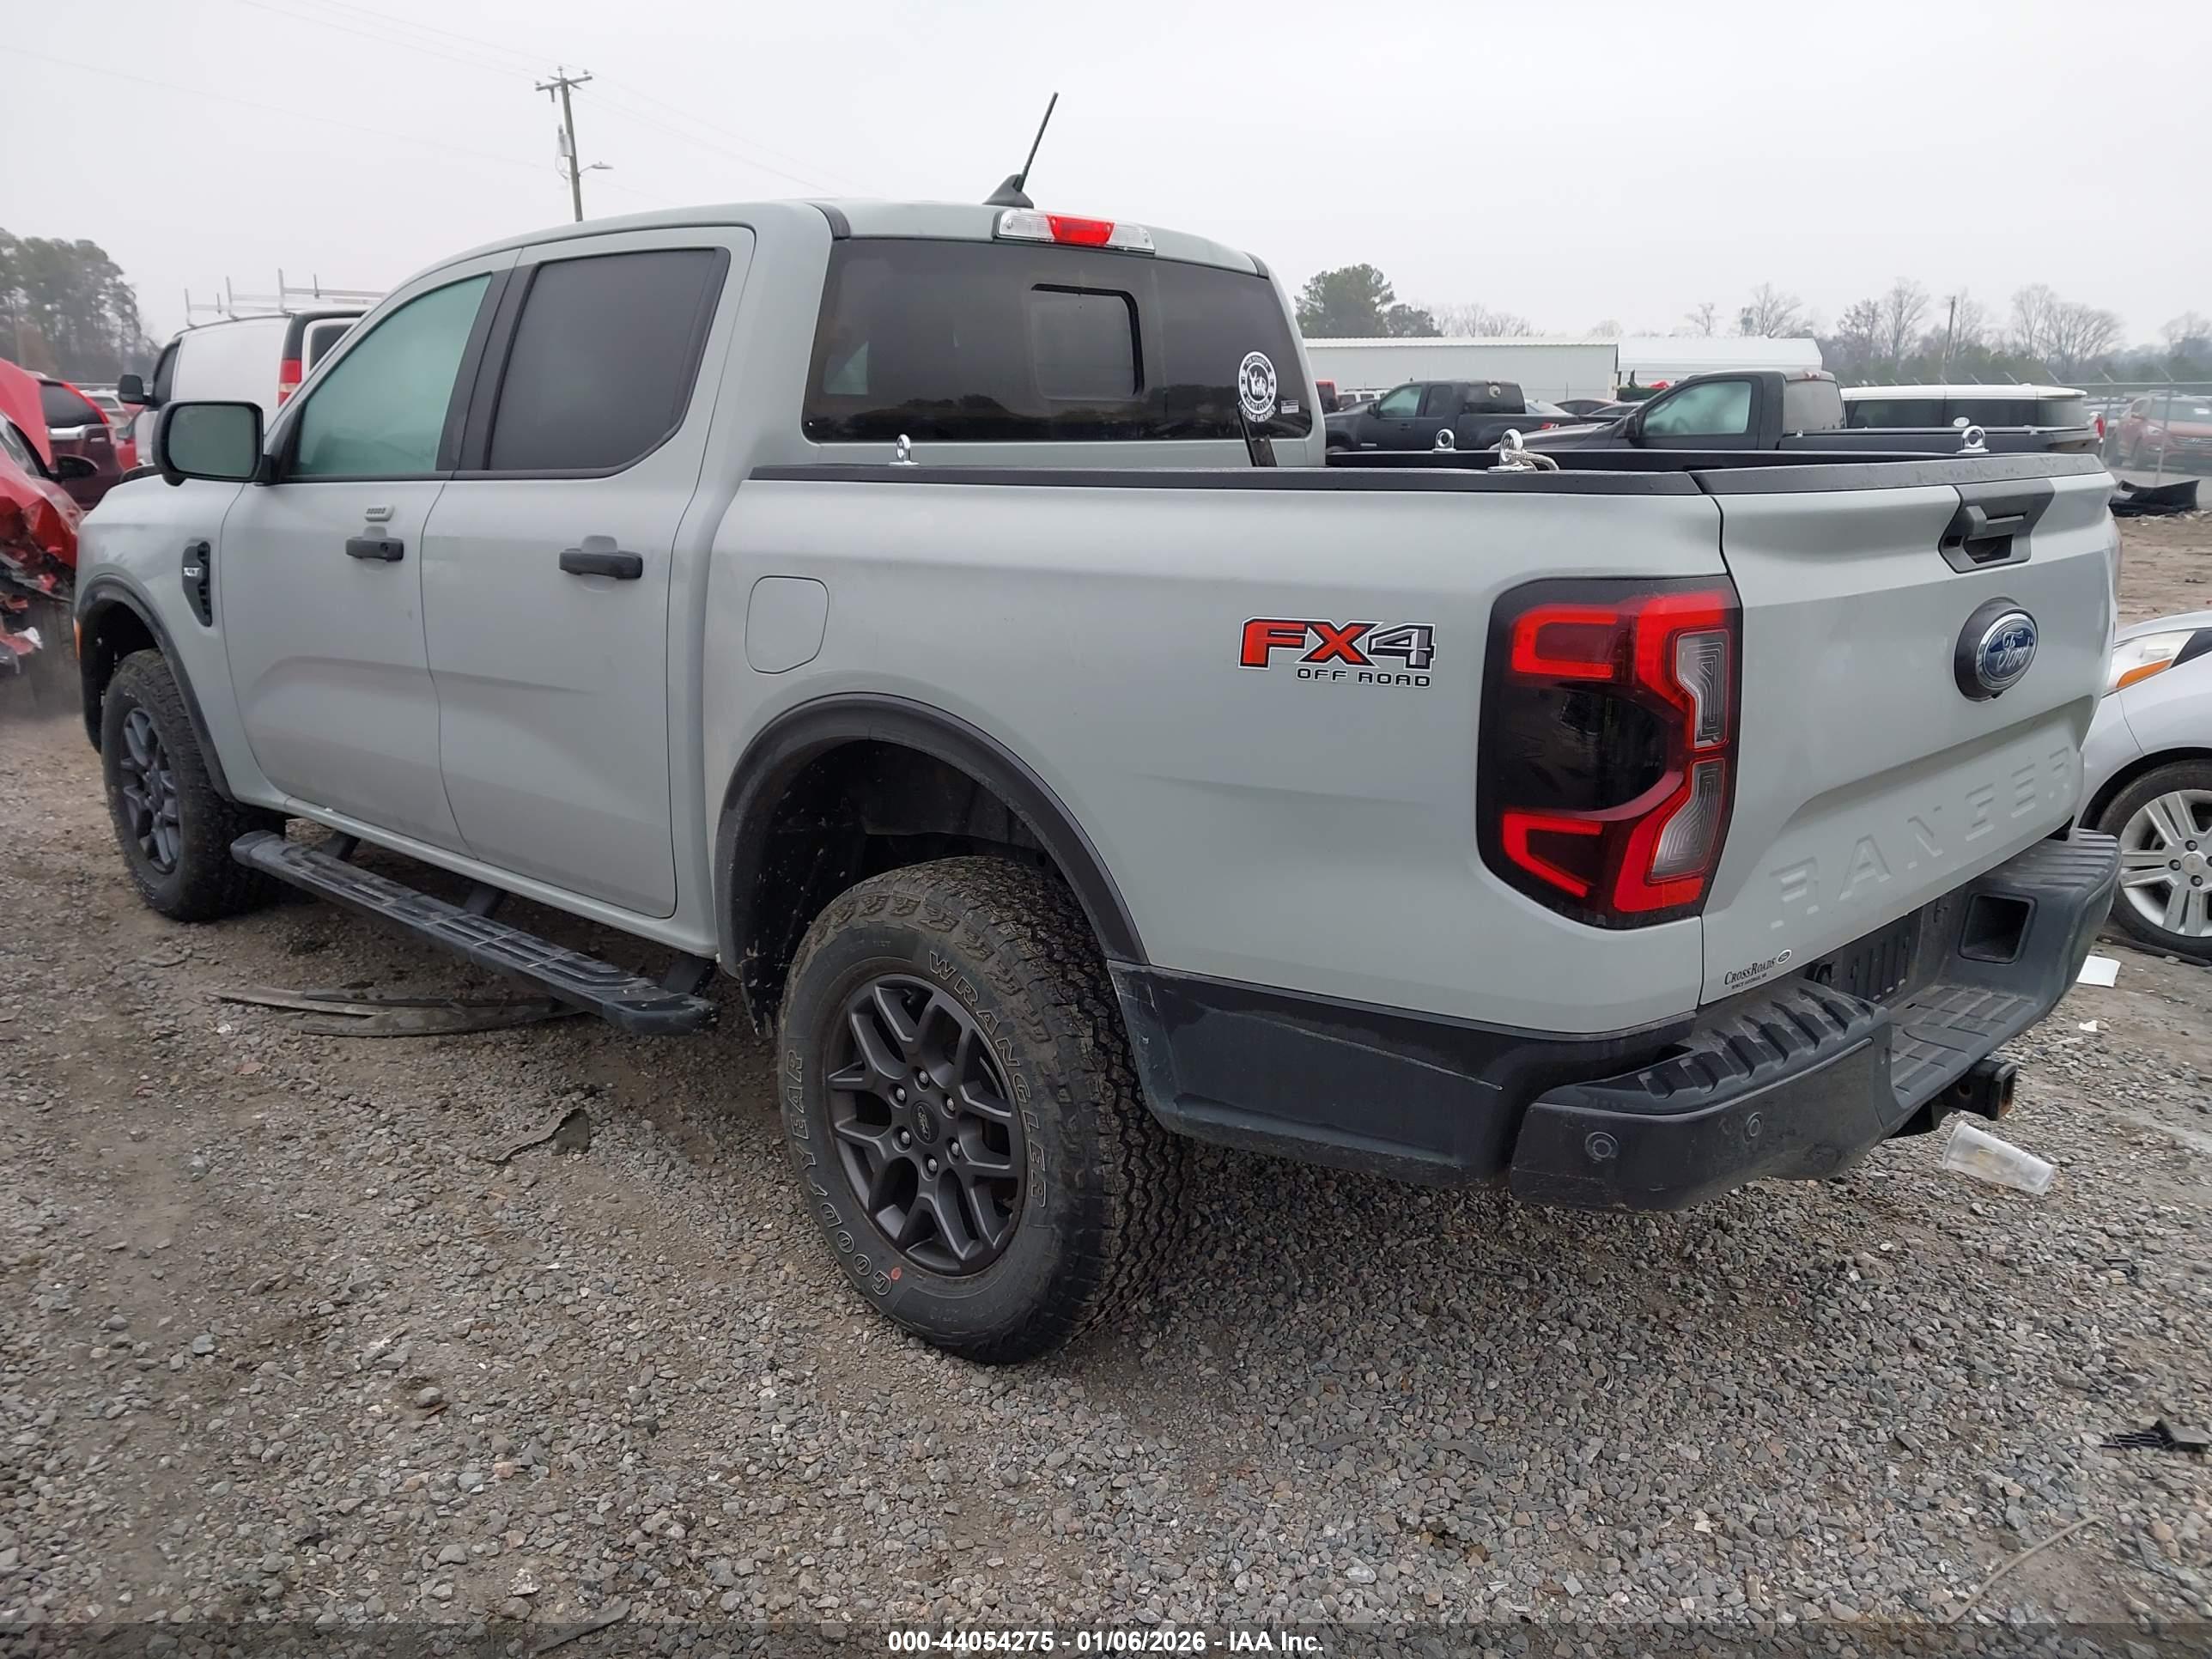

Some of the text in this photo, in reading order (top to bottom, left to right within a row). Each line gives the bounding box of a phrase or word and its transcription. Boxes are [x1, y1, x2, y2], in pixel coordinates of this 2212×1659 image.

[1238, 617, 1437, 671] FX4
[1996, 629, 2032, 672] Ford
[1297, 667, 1431, 688] OFF ROAD
[1768, 745, 2071, 931] RANGER
[928, 949, 1047, 1209] WRANGLER
